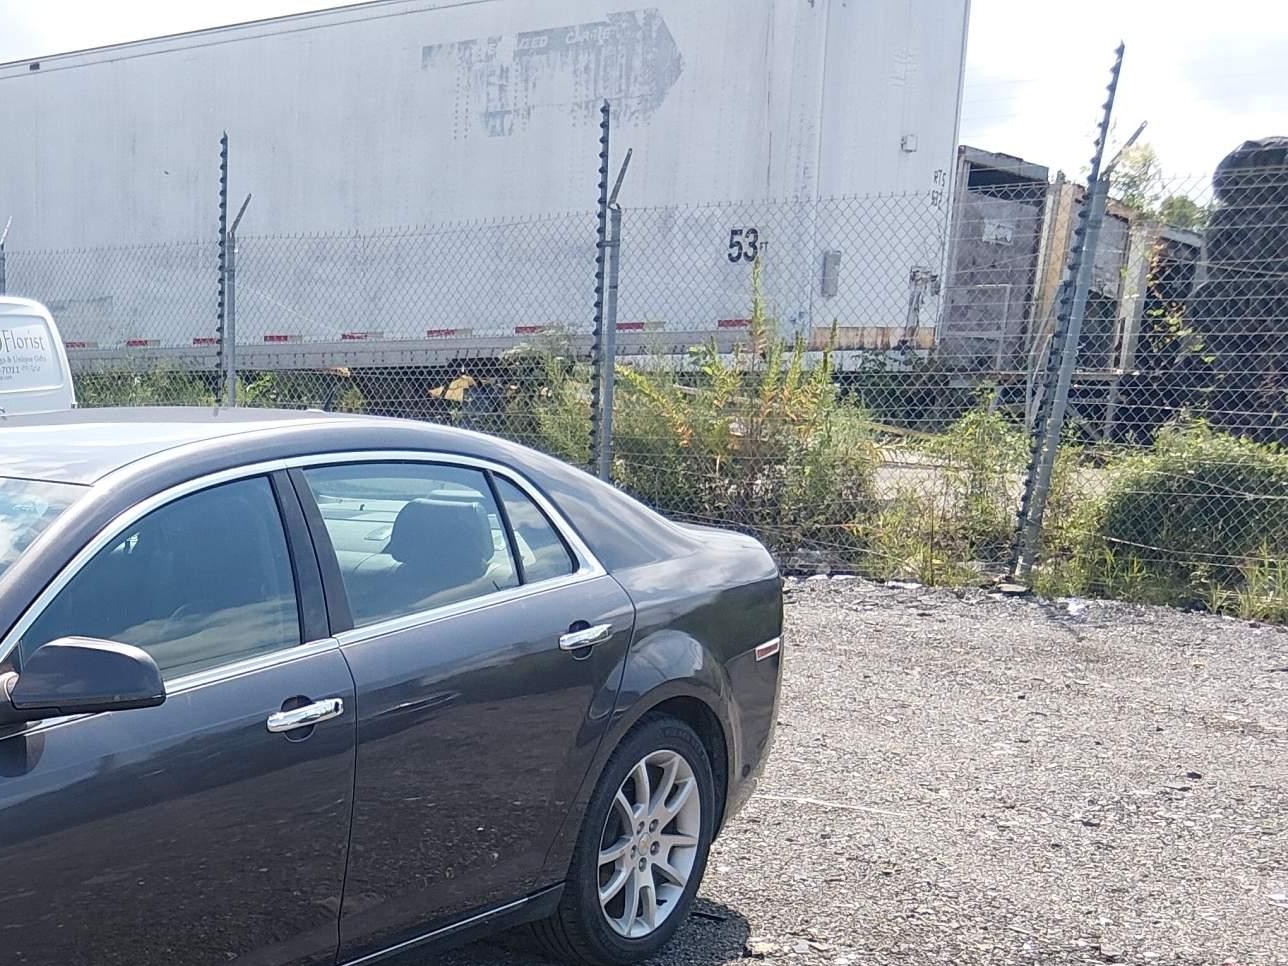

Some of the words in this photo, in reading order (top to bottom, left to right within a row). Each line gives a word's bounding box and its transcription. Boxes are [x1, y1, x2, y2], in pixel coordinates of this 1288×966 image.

[727, 227, 759, 263] 53
[759, 241, 769, 252] FT
[2, 329, 45, 353] Florist
